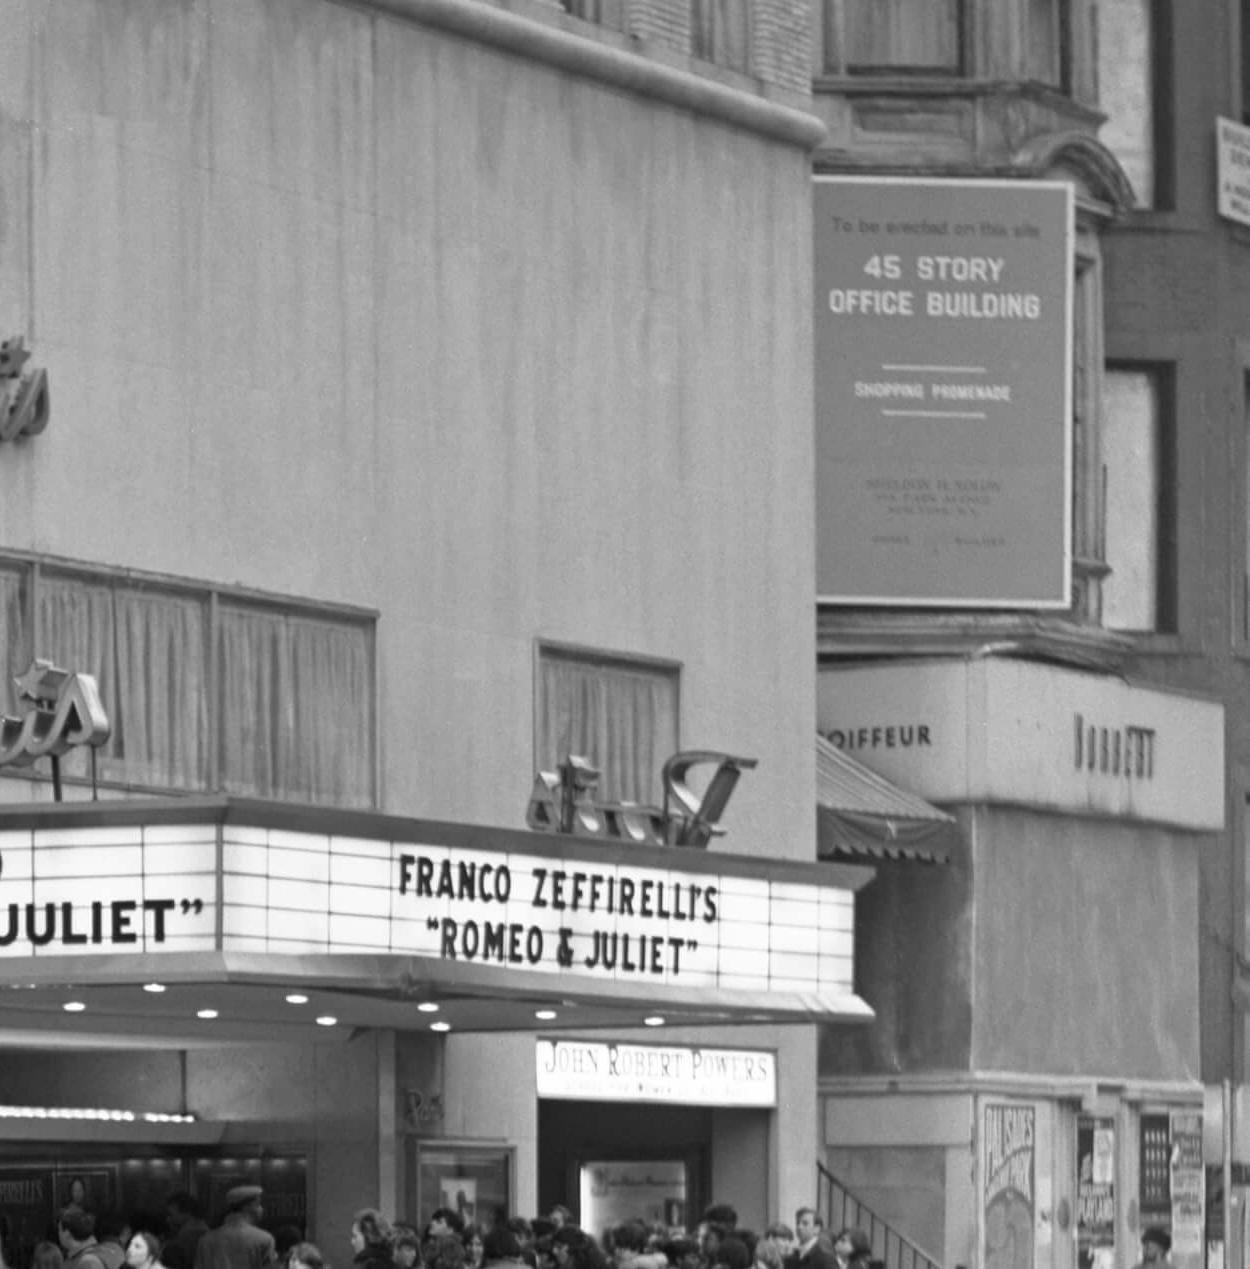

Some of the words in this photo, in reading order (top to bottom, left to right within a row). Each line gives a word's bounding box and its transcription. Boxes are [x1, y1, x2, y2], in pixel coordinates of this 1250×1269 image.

[832, 217, 852, 234] To
[859, 219, 880, 234] be
[885, 220, 948, 237] erected
[954, 224, 975, 237] on
[980, 221, 1007, 238] this
[863, 254, 903, 280] 45
[916, 255, 1006, 283] STORY
[829, 289, 914, 316] OFFICE
[925, 291, 1041, 320] BUILDING
[854, 381, 924, 400] SHOPPING
[932, 383, 1011, 403] PROMENADE
[817, 725, 932, 750] OIFFEUR
[399, 854, 511, 904] FRANCO
[532, 868, 717, 923] ZEFFIRELLI'S
[557, 927, 574, 968] &
[545, 1042, 600, 1075] JOHN
[607, 1045, 684, 1080] ROBERT
[690, 1050, 768, 1083] POWERS
